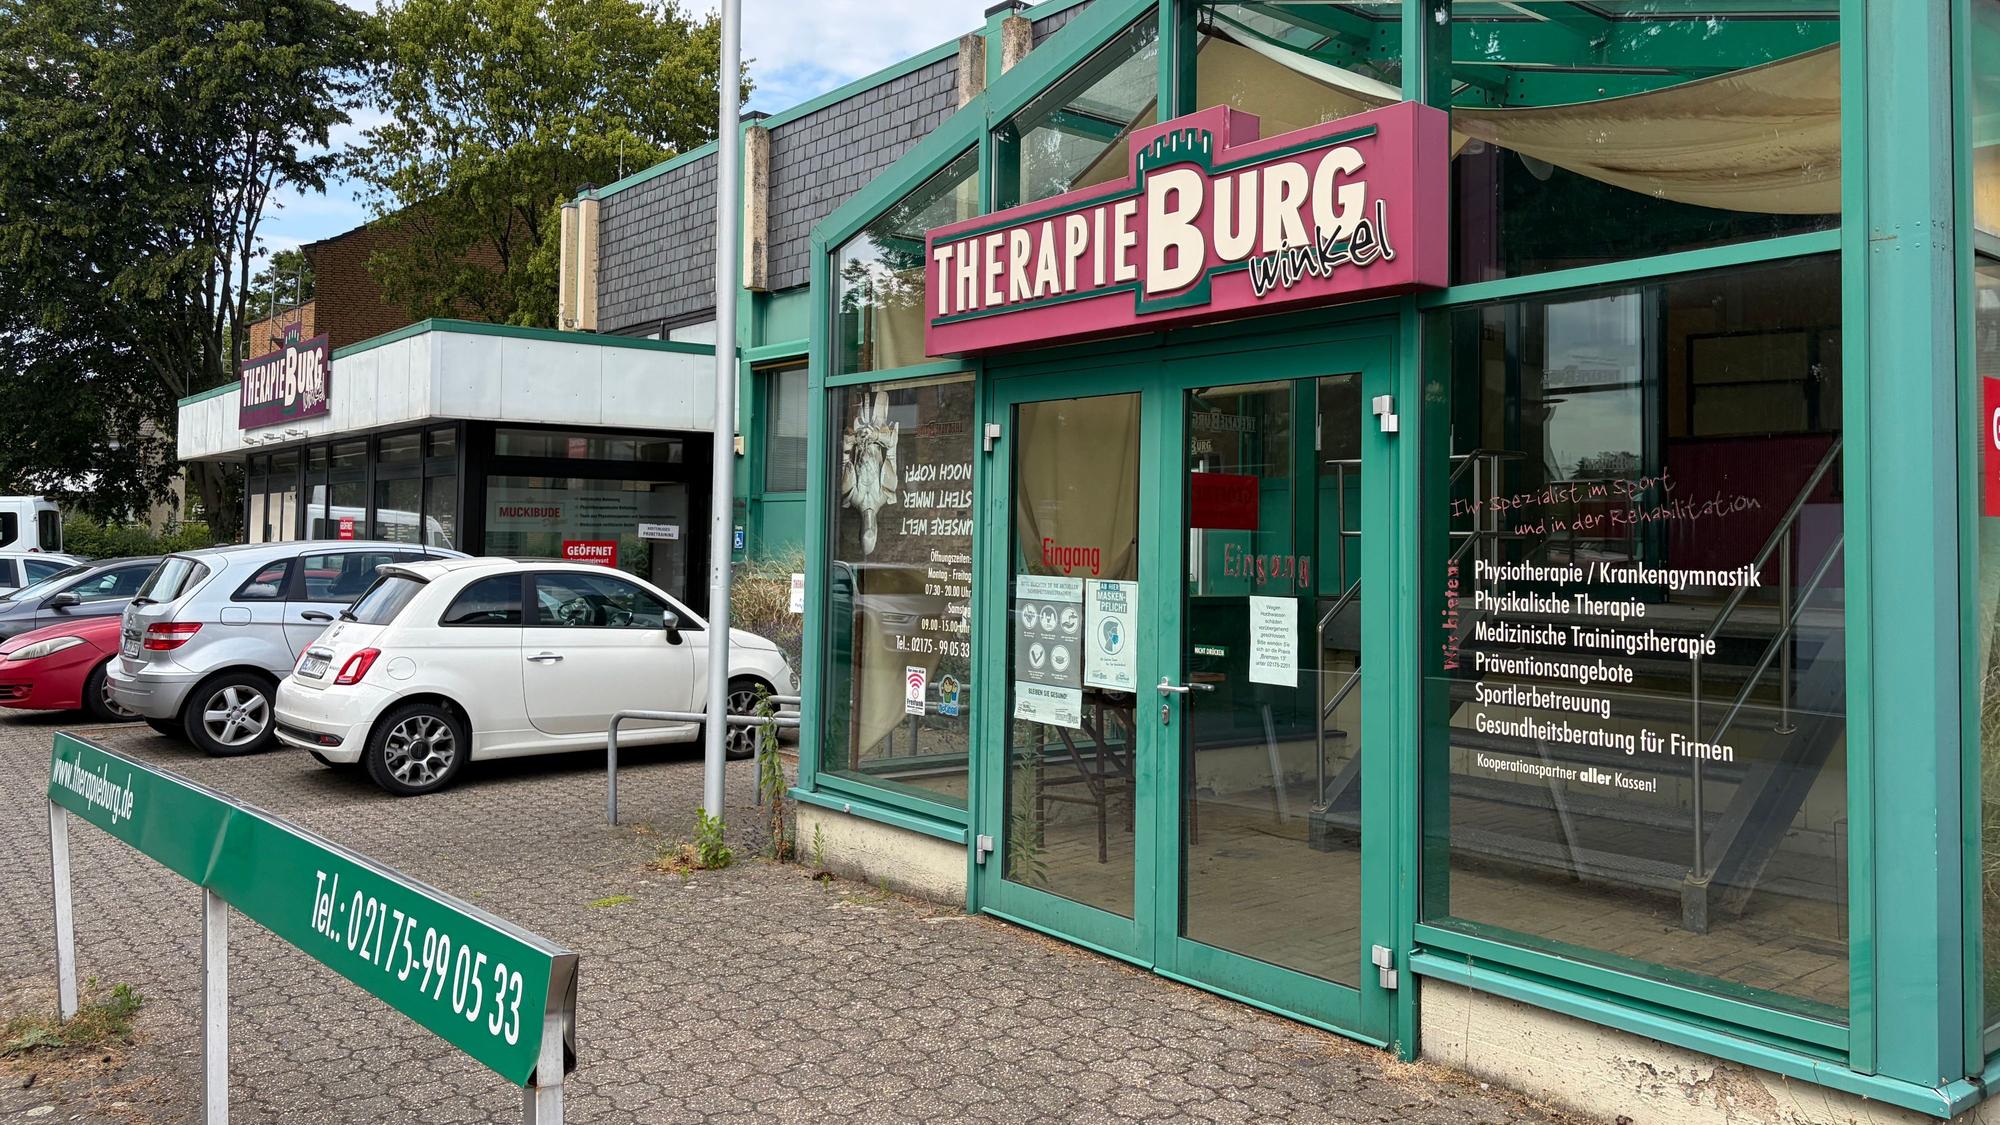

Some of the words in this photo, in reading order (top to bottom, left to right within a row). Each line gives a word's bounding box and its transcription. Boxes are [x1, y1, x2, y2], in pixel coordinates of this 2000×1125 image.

[905, 464, 936, 483] KOPF!
[940, 463, 972, 480] NOCH
[903, 491, 935, 508] IMMER
[937, 490, 973, 508] STEHT
[1450, 498, 1482, 517] Ihr
[1587, 482, 1608, 498] im
[1613, 467, 1677, 499] Sport
[500, 506, 561, 518] MUCKIBUDE
[1514, 518, 1546, 536] und
[1551, 516, 1567, 532] in
[1572, 512, 1603, 530] der
[1611, 490, 1762, 528] Rehabilitation
[900, 518, 928, 536] WELT
[931, 517, 974, 536] UNSERE
[567, 543, 613, 556] GEÖFFNET
[930, 548, 972, 565] Öffnungszeiten:
[1042, 537, 1101, 575] Eingang
[1224, 543, 1311, 588] Eingang
[1475, 560, 1583, 586] Physiotherapie
[1587, 561, 1595, 585] /
[1600, 562, 1761, 590] Krankengymnastik
[928, 568, 948, 582] Montag
[953, 568, 972, 583] Freitag
[925, 584, 940, 596] 07.30
[945, 585, 960, 597] 20.00
[961, 586, 972, 598] Uhr
[1097, 591, 1126, 601] MASKEN-
[947, 602, 971, 618] Samstag
[1101, 602, 1127, 613] PFLICHT
[1475, 590, 1570, 616] Physikalische
[1574, 593, 1645, 622] Therapie
[921, 618, 938, 631] 09.00
[896, 635, 910, 651] Tel.:
[912, 637, 933, 653] 02175
[939, 640, 948, 655] 99
[950, 641, 959, 656] 05
[961, 642, 970, 658] 33
[1475, 621, 1567, 646] Medizinische
[1570, 625, 1716, 659] Trainingstherapie
[1475, 652, 1634, 685] Präventionsangebote
[1475, 682, 1611, 719] Sportlerbetreuung
[1475, 713, 1635, 755] Gesundheitsberatung
[1640, 728, 1665, 753] für
[1670, 733, 1734, 762] Firmen
[1477, 753, 1578, 781] Kooperationspartner
[1580, 768, 1612, 786] aller
[1615, 772, 1657, 793] Kassen!
[52, 757, 134, 825] www.therapieburg.de
[311, 869, 345, 942] Tel.:
[347, 890, 450, 1001] 02175-99
[452, 944, 487, 1023] 05
[488, 963, 524, 1046] 33
